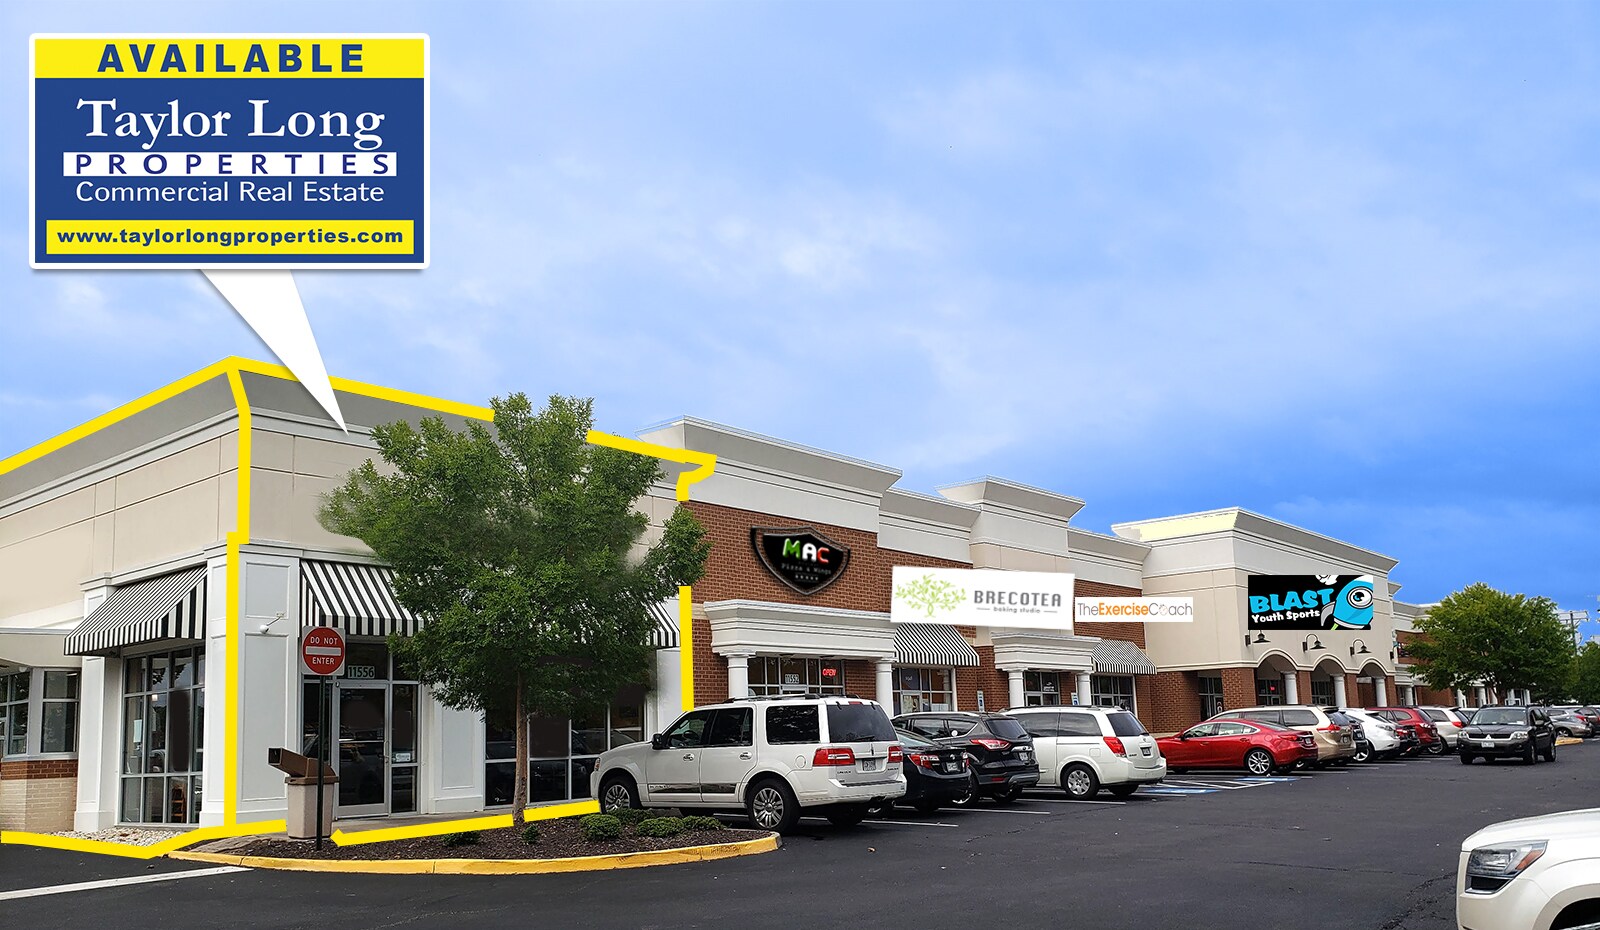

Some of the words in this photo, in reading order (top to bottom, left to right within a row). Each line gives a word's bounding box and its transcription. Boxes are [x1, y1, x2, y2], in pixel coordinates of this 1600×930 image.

[782, 538, 830, 564] MAC
[973, 590, 1062, 607] BRECOTEA
[1249, 588, 1335, 614] BLAST
[993, 606, 1018, 614] baking
[1251, 612, 1285, 624] Youth
[1285, 609, 1321, 622] Sports
[310, 636, 320, 644] DO
[323, 637, 338, 645] NOT
[312, 656, 335, 665] ENTER
[348, 666, 375, 679] 11556
[822, 668, 837, 677] OPEN
